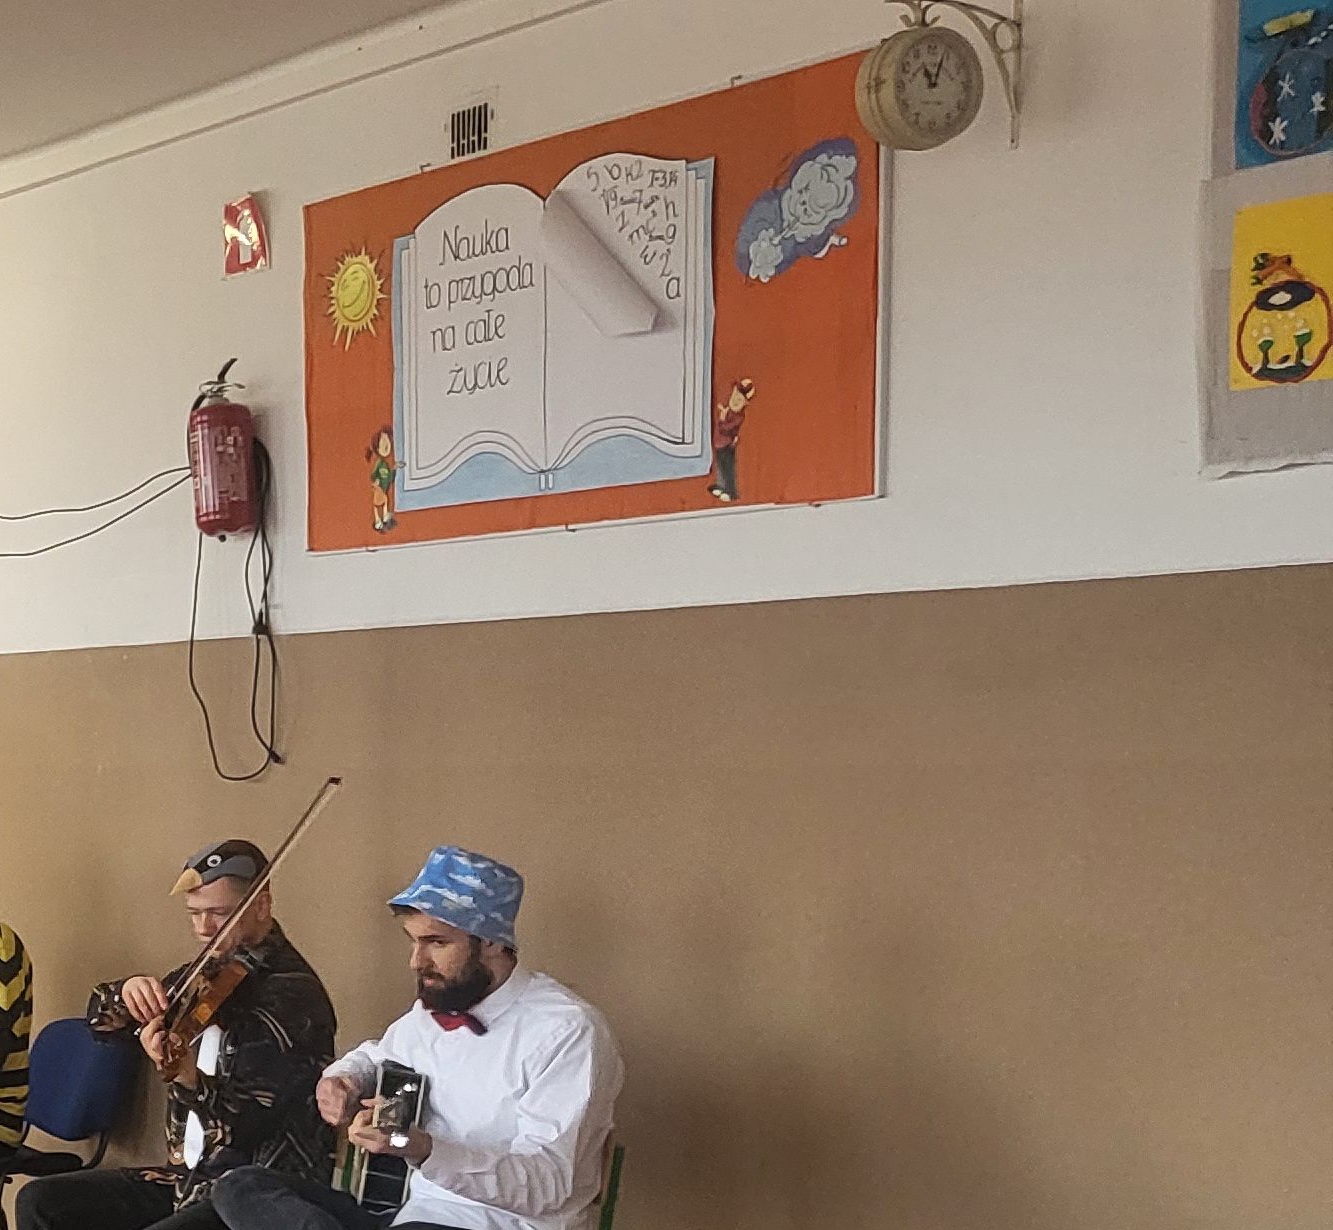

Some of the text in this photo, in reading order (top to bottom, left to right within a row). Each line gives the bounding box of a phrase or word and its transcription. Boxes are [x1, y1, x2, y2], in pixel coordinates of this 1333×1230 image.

[438, 218, 510, 266] Nauka
[423, 254, 535, 311] to przygoda
[430, 308, 506, 353] na całe
[446, 356, 510, 396] życie
